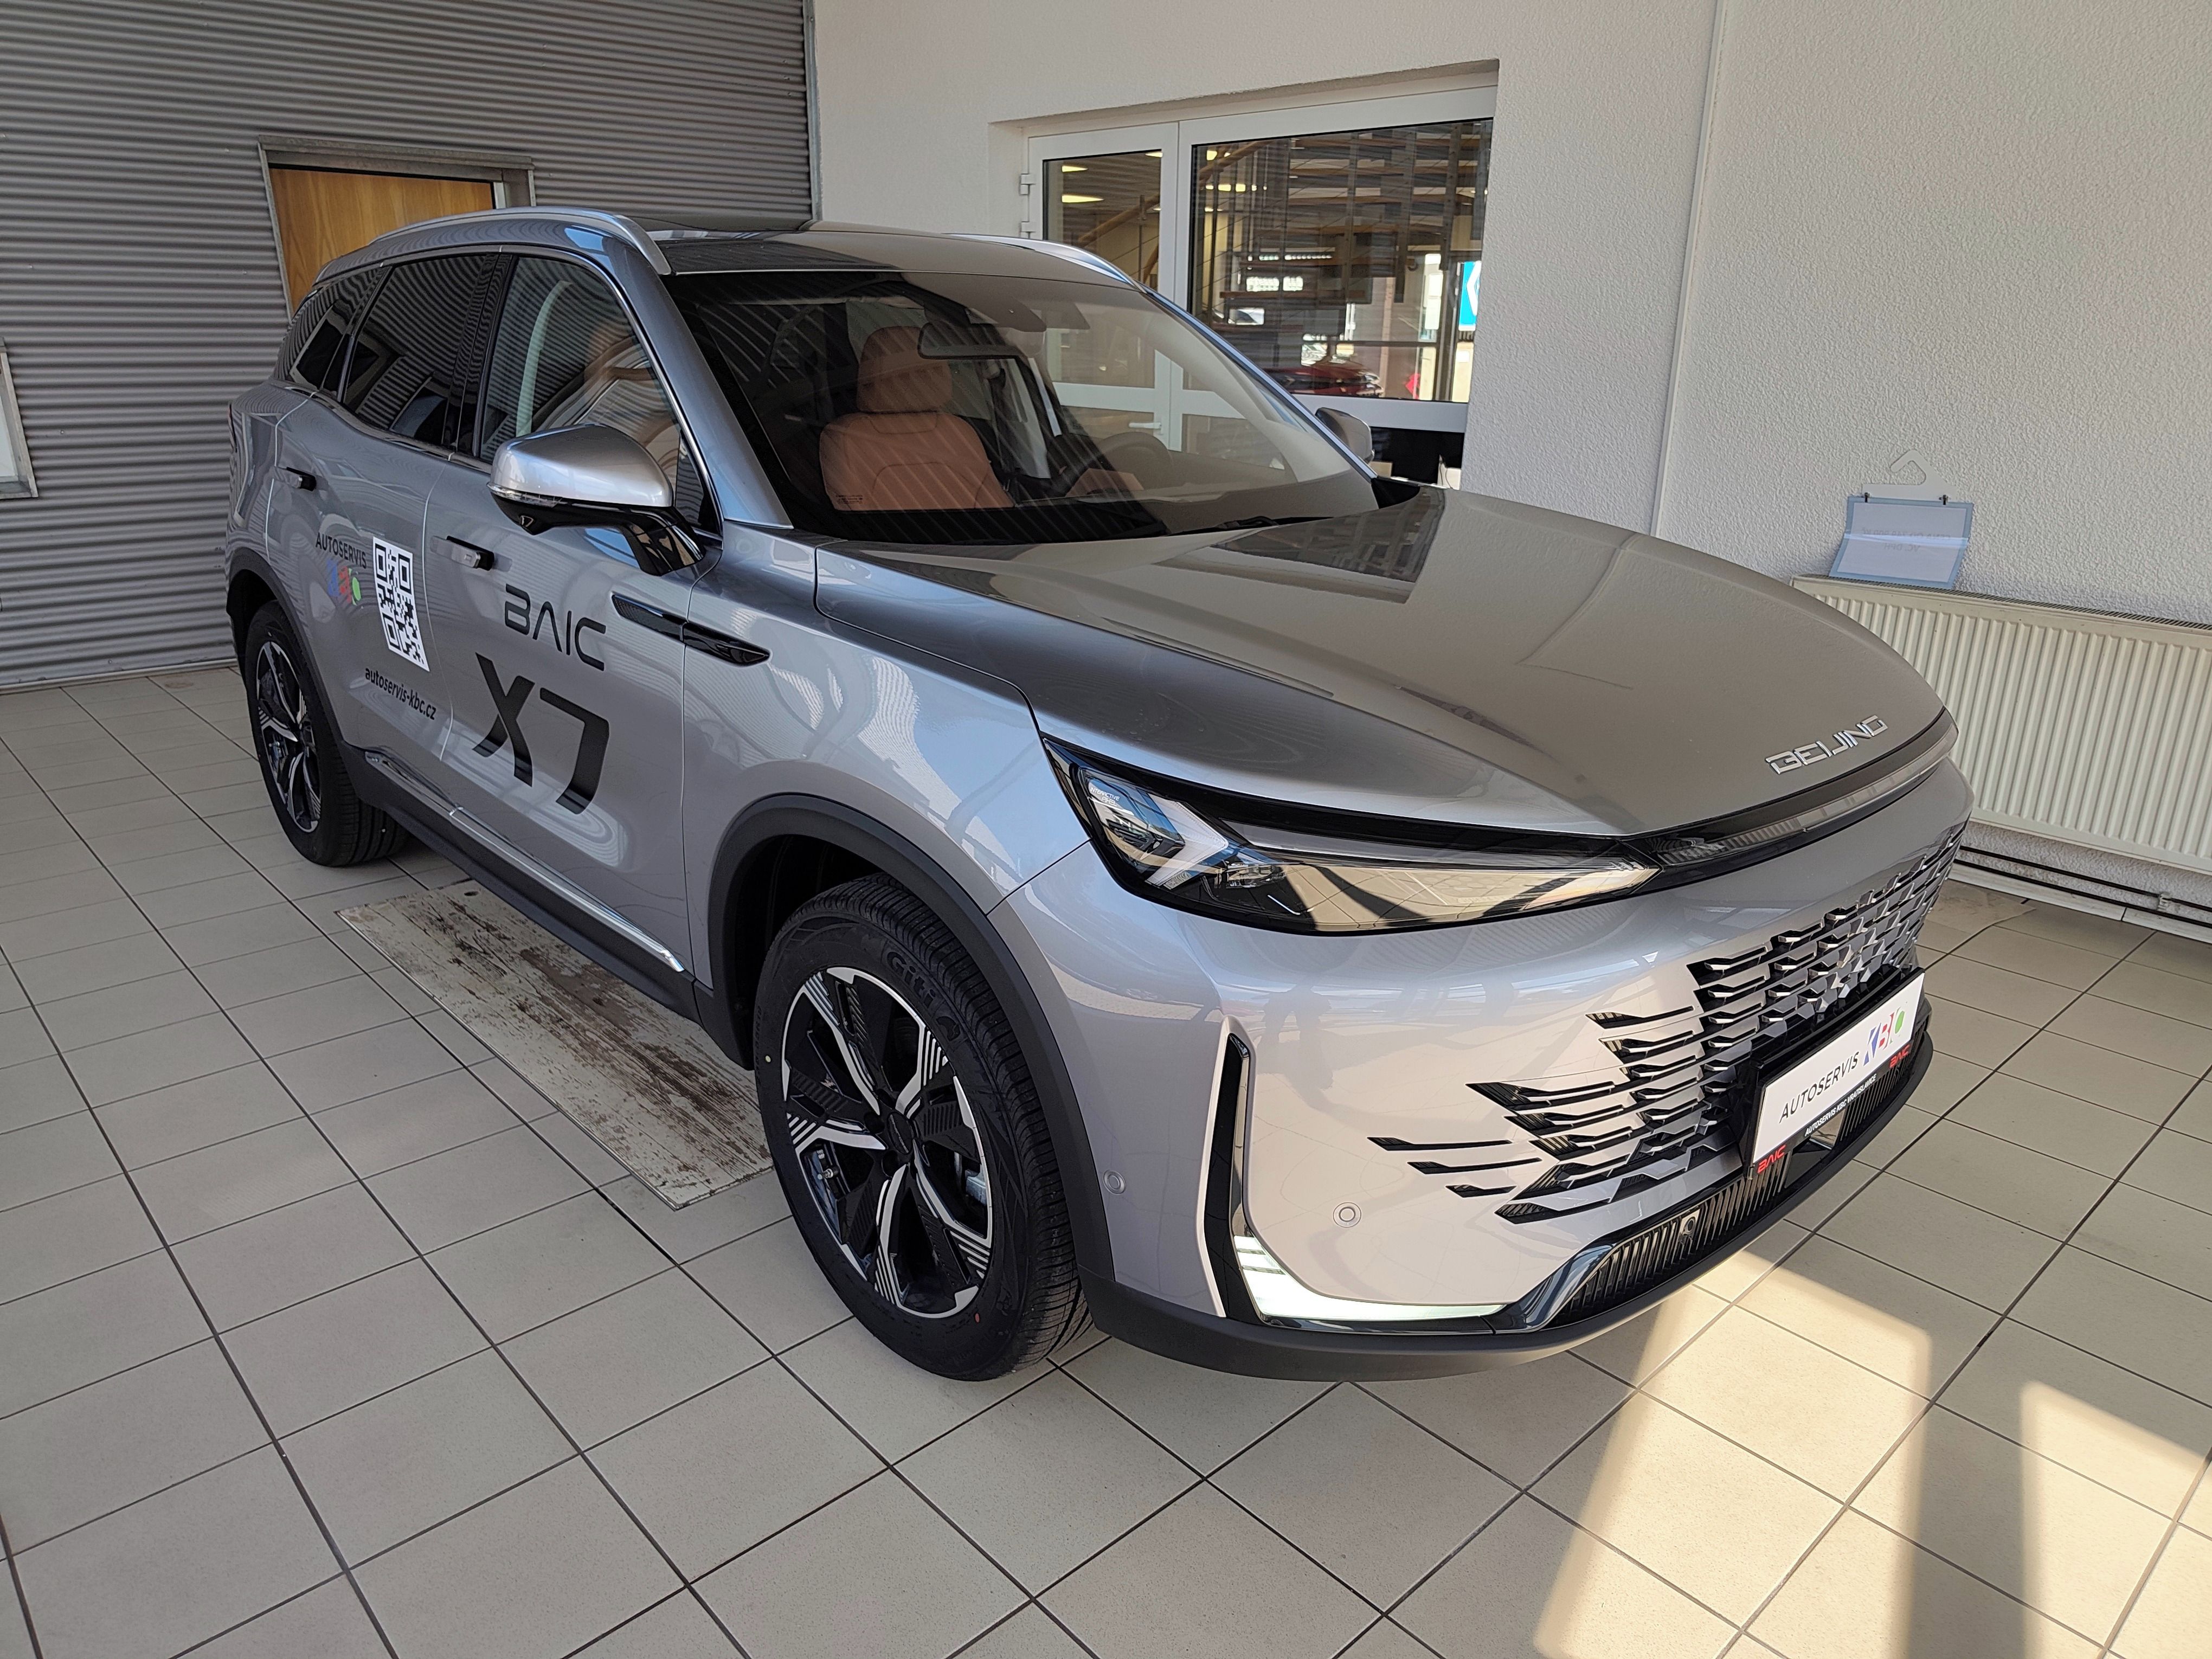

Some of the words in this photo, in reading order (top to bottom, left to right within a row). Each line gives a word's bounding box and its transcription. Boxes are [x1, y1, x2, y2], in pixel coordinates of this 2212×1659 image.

[316, 532, 366, 569] AUTOSERVIS
[505, 583, 606, 671] BAIC
[365, 668, 436, 720] autoservis-kbc.cz
[472, 652, 610, 814] X7
[1765, 715, 1888, 774] BEIJING
[1090, 787, 1120, 801] INTERACTIVE
[1102, 796, 1117, 807] PIXEL
[887, 951, 936, 1008] Giti
[1889, 1044, 1911, 1069] BAIC
[1779, 1051, 1860, 1123] AUTOSERVIS
[1805, 1107, 1837, 1137] AUTOSERVIS
[1836, 1099, 1847, 1113] KBC
[1847, 1073, 1876, 1103] VRATISLAVICE
[1757, 1144, 1786, 1174] BAIC
